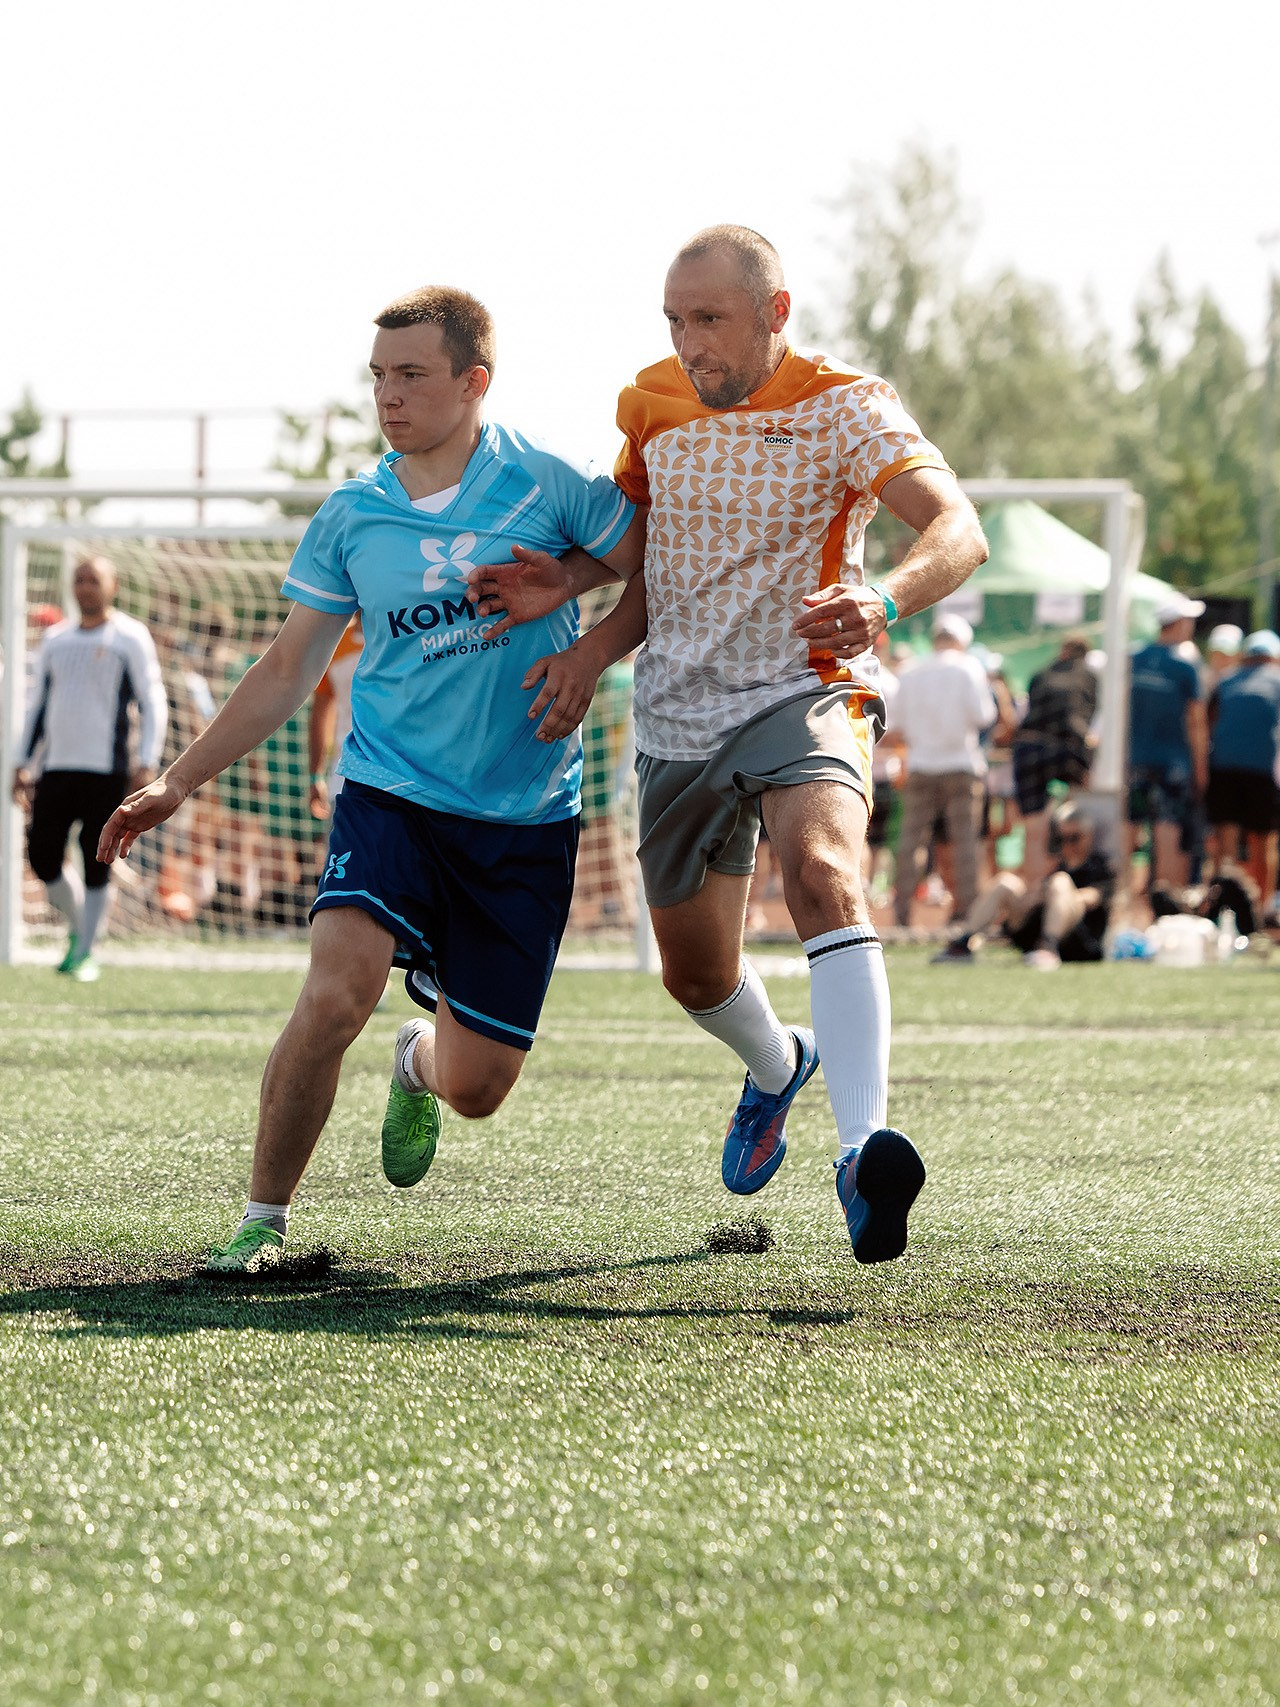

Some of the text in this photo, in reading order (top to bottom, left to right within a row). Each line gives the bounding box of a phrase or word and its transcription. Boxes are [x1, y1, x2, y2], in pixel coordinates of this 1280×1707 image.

[764, 436, 794, 445] КОМОС
[387, 595, 508, 639] КОМ
[421, 620, 510, 651] МИЛКО
[422, 636, 511, 663] ИЖМОЛОКО
